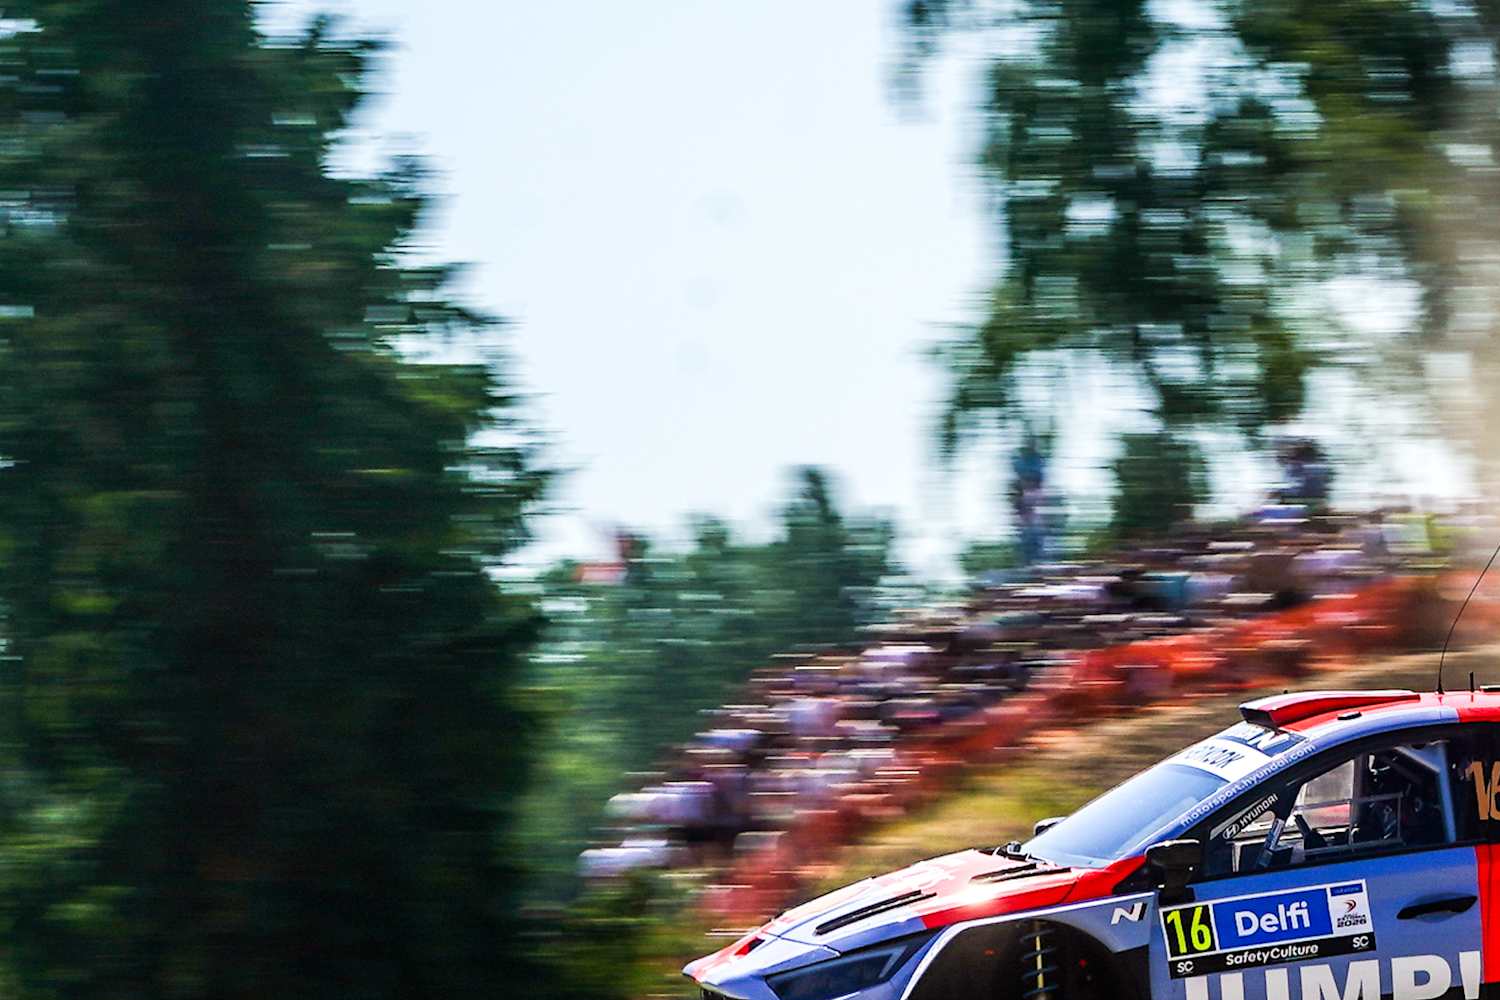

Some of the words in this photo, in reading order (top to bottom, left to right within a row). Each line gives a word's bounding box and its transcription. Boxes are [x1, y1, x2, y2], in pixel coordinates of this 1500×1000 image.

[1181, 744, 1317, 828] motorsport.hyundai.com
[1240, 793, 1279, 828] HYUNDAI
[1166, 905, 1212, 953] 16
[1234, 900, 1311, 937] Delfi
[1225, 943, 1319, 966] SafetyCulture
[1353, 935, 1370, 948] SC
[1176, 960, 1194, 973] SC
